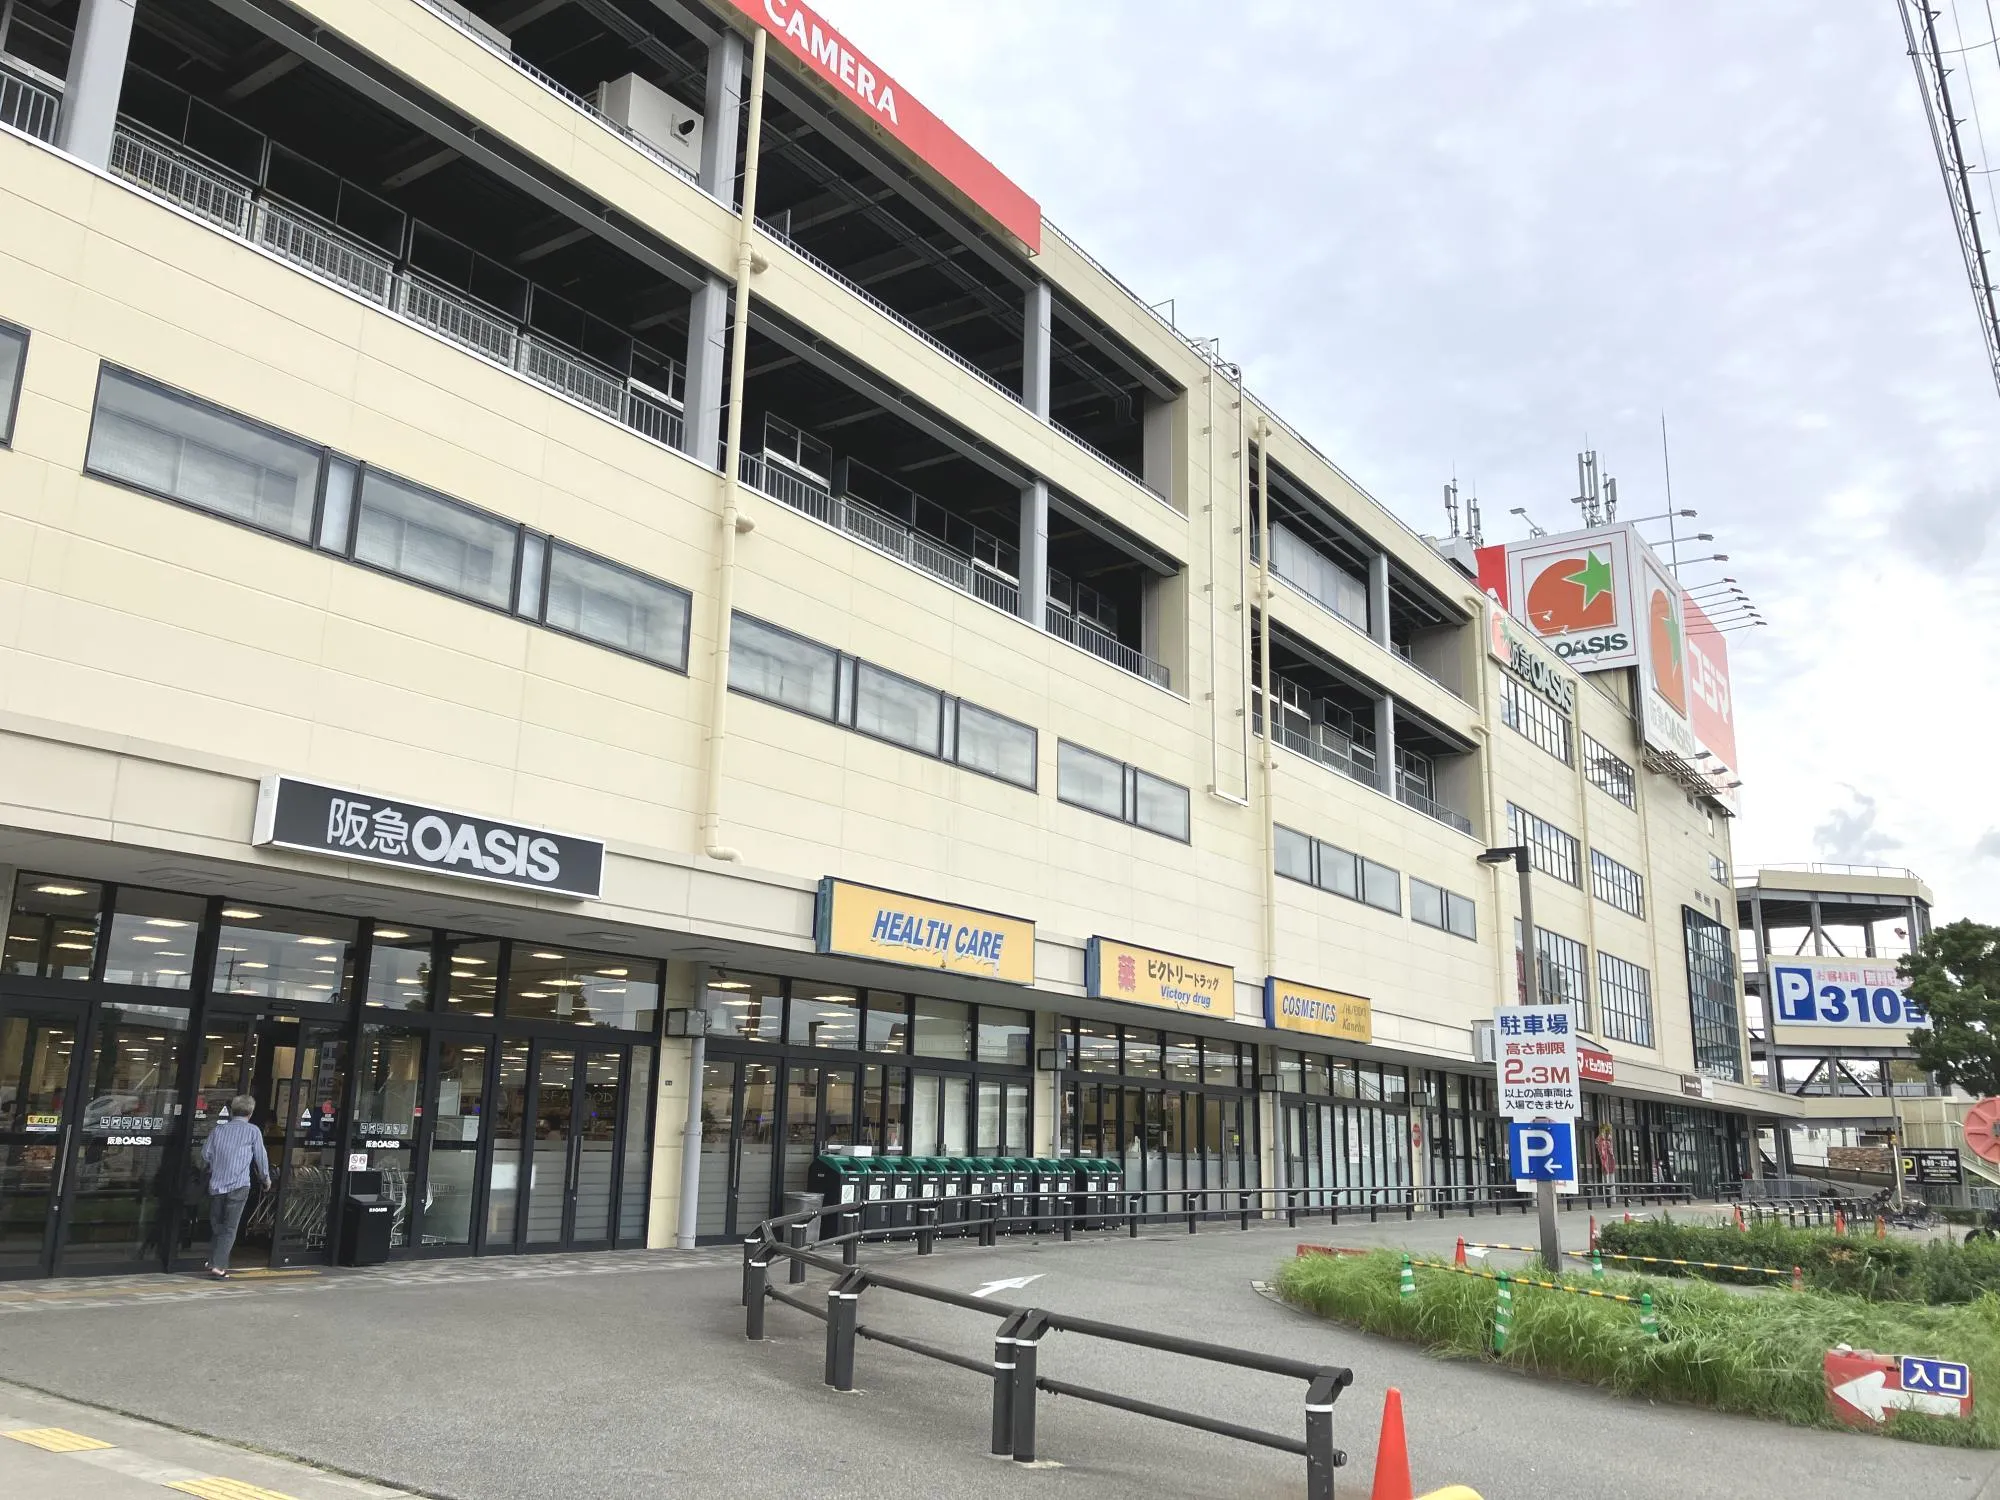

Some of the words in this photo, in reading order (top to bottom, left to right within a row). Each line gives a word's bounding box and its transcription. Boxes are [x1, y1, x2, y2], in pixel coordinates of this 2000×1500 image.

[763, 0, 899, 125] CAMERA
[1554, 632, 1629, 659] OASIS
[326, 797, 560, 882] 阪急OASIS
[872, 910, 952, 950] HEALTH
[954, 926, 1005, 960] CARE
[1148, 959, 1219, 991] ビクトリードラッグ
[1161, 985, 1191, 1004] Victory
[1192, 992, 1211, 1007] drug
[1780, 972, 1810, 1016] P
[1282, 995, 1336, 1022] COSMETICS
[1500, 1013, 1568, 1035] 駐車場
[1505, 1042, 1566, 1056] 高さ制限
[1505, 1058, 1571, 1085] 2.3M
[1505, 1088, 1573, 1098] 以上の高車両は
[1505, 1100, 1574, 1110] 入場できません
[1519, 1129, 1554, 1174] P
[1908, 1363, 1961, 1390] 入口
